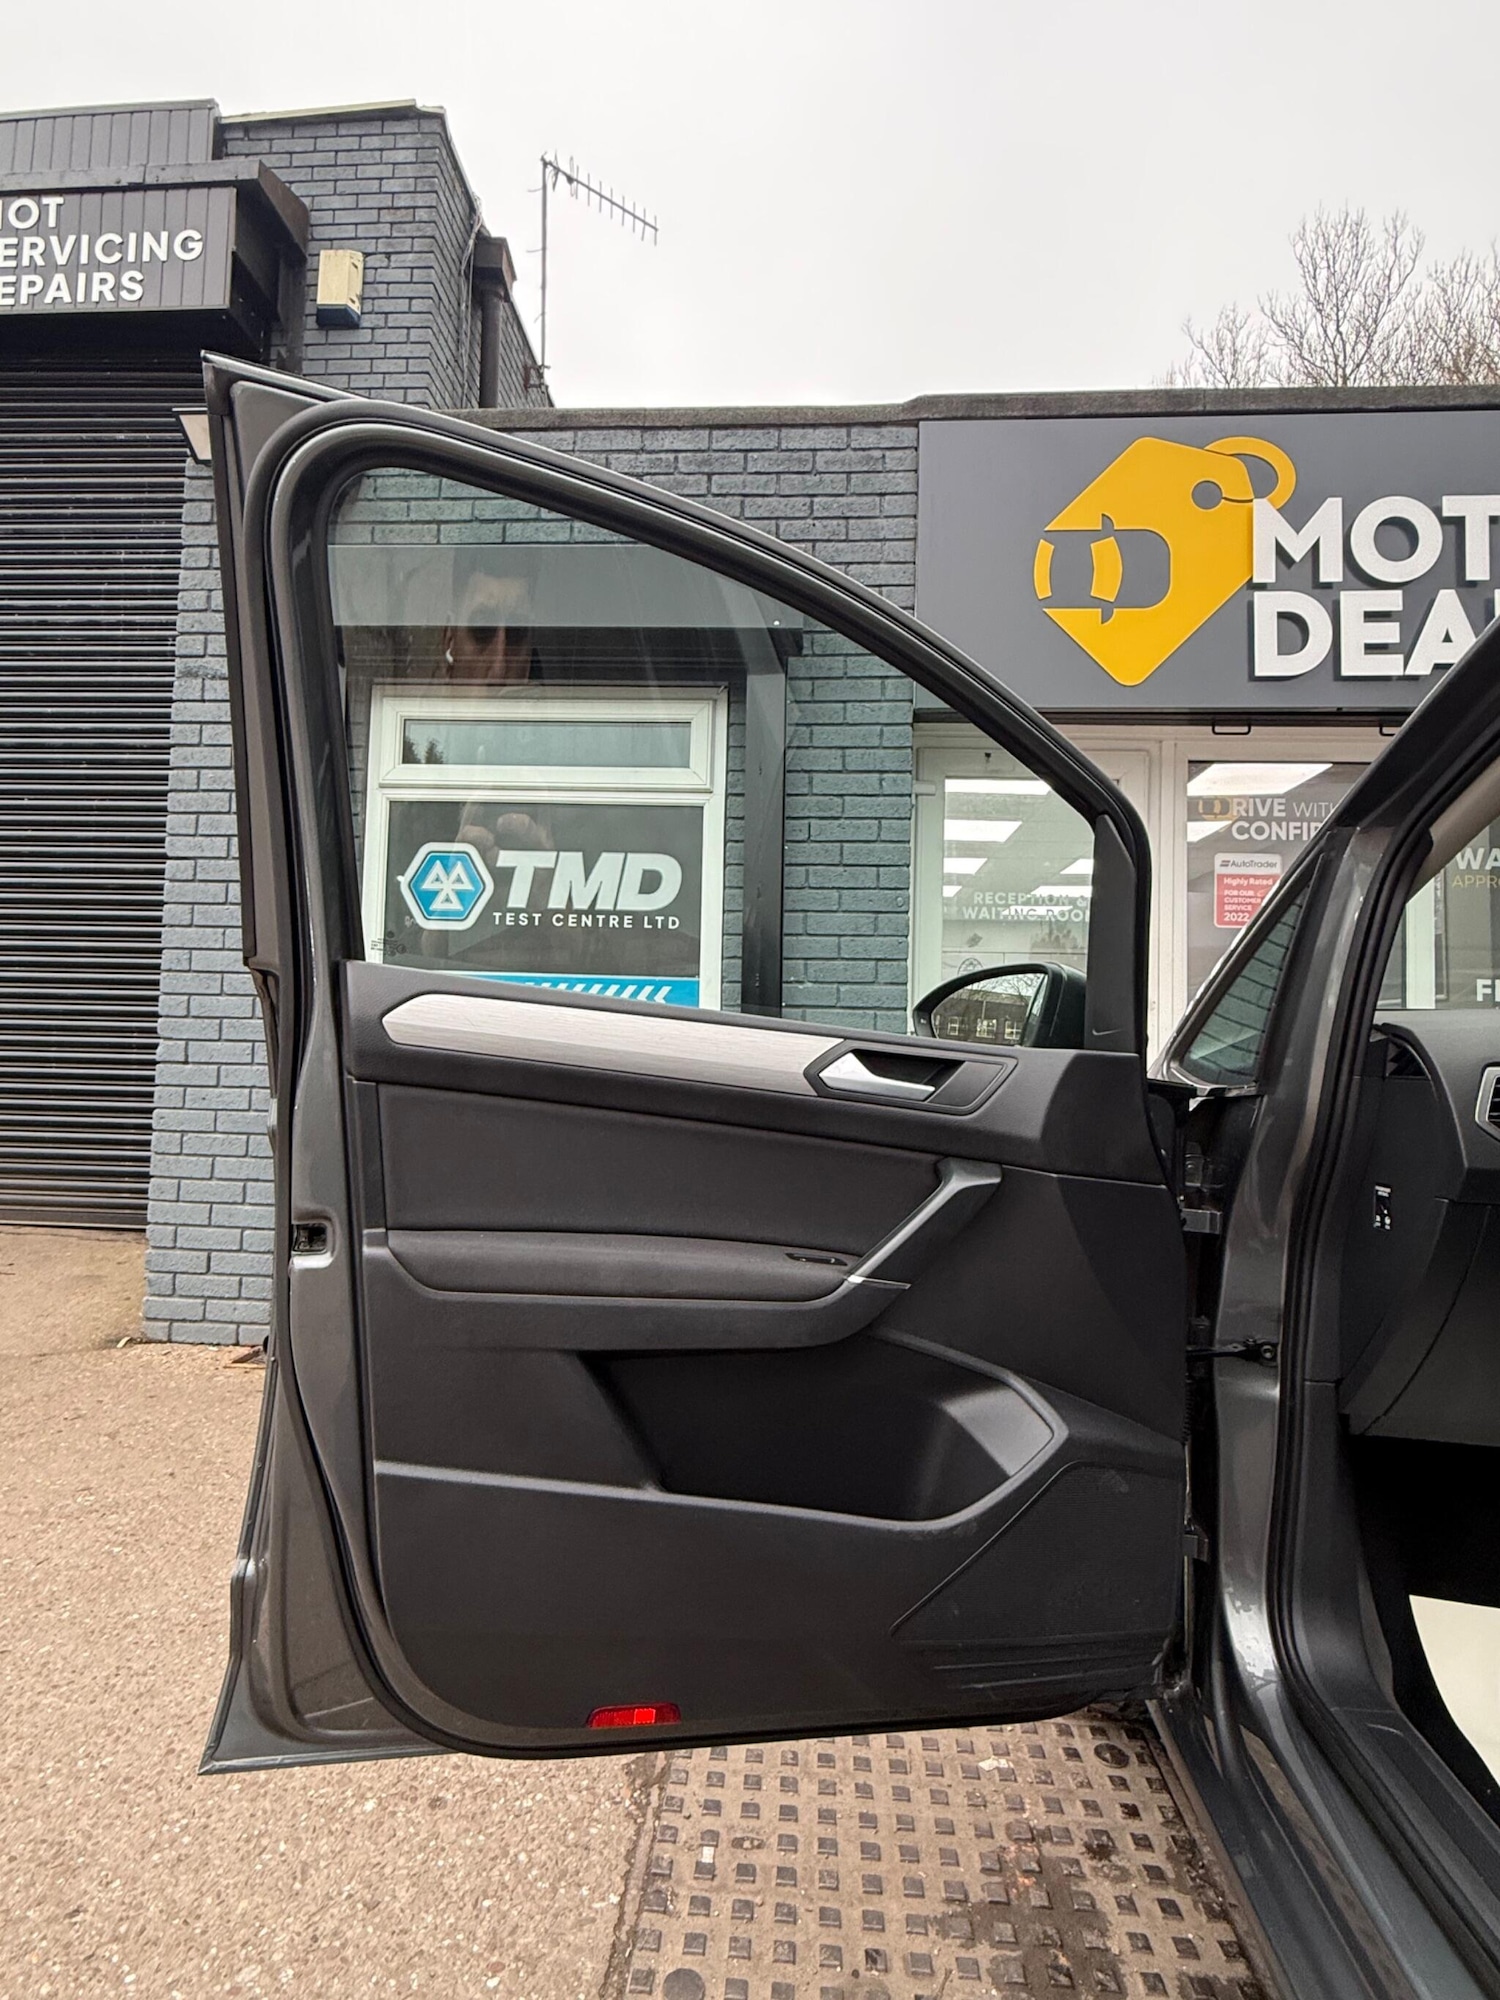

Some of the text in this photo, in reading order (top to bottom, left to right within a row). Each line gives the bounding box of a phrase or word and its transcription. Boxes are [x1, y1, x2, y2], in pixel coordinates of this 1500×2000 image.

[0, 196, 65, 230] OT
[1254, 588, 1500, 677] DEA
[1231, 860, 1278, 869] AutoTrader
[495, 850, 683, 912] TMD
[1224, 878, 1273, 887] Highly Rated
[1452, 875, 1500, 889] APPR
[973, 891, 1070, 906] RECEPTION
[493, 912, 680, 930] TEST CENTRE LTD
[962, 906, 1037, 921] WAITING
[1224, 912, 1250, 922] 2022
